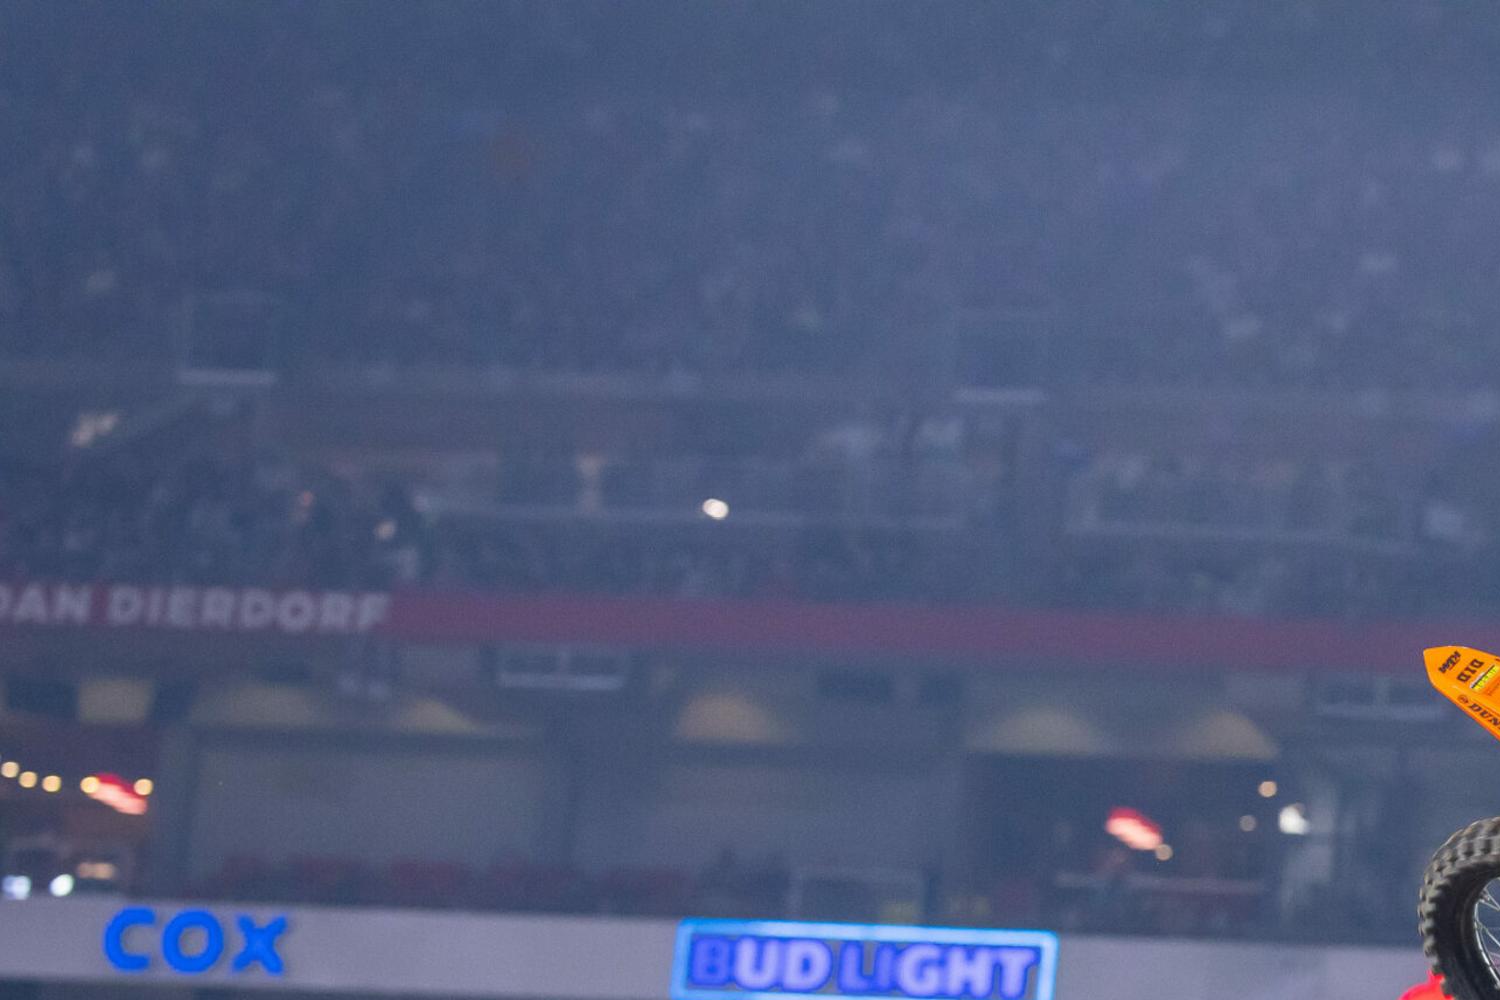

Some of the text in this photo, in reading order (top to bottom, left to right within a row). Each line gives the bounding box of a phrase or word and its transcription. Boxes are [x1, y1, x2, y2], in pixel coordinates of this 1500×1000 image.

[106, 585, 391, 633] DIERDORF
[1457, 658, 1485, 683] DID
[104, 907, 288, 976] COX
[691, 935, 1041, 1000] BUD LIGHT
